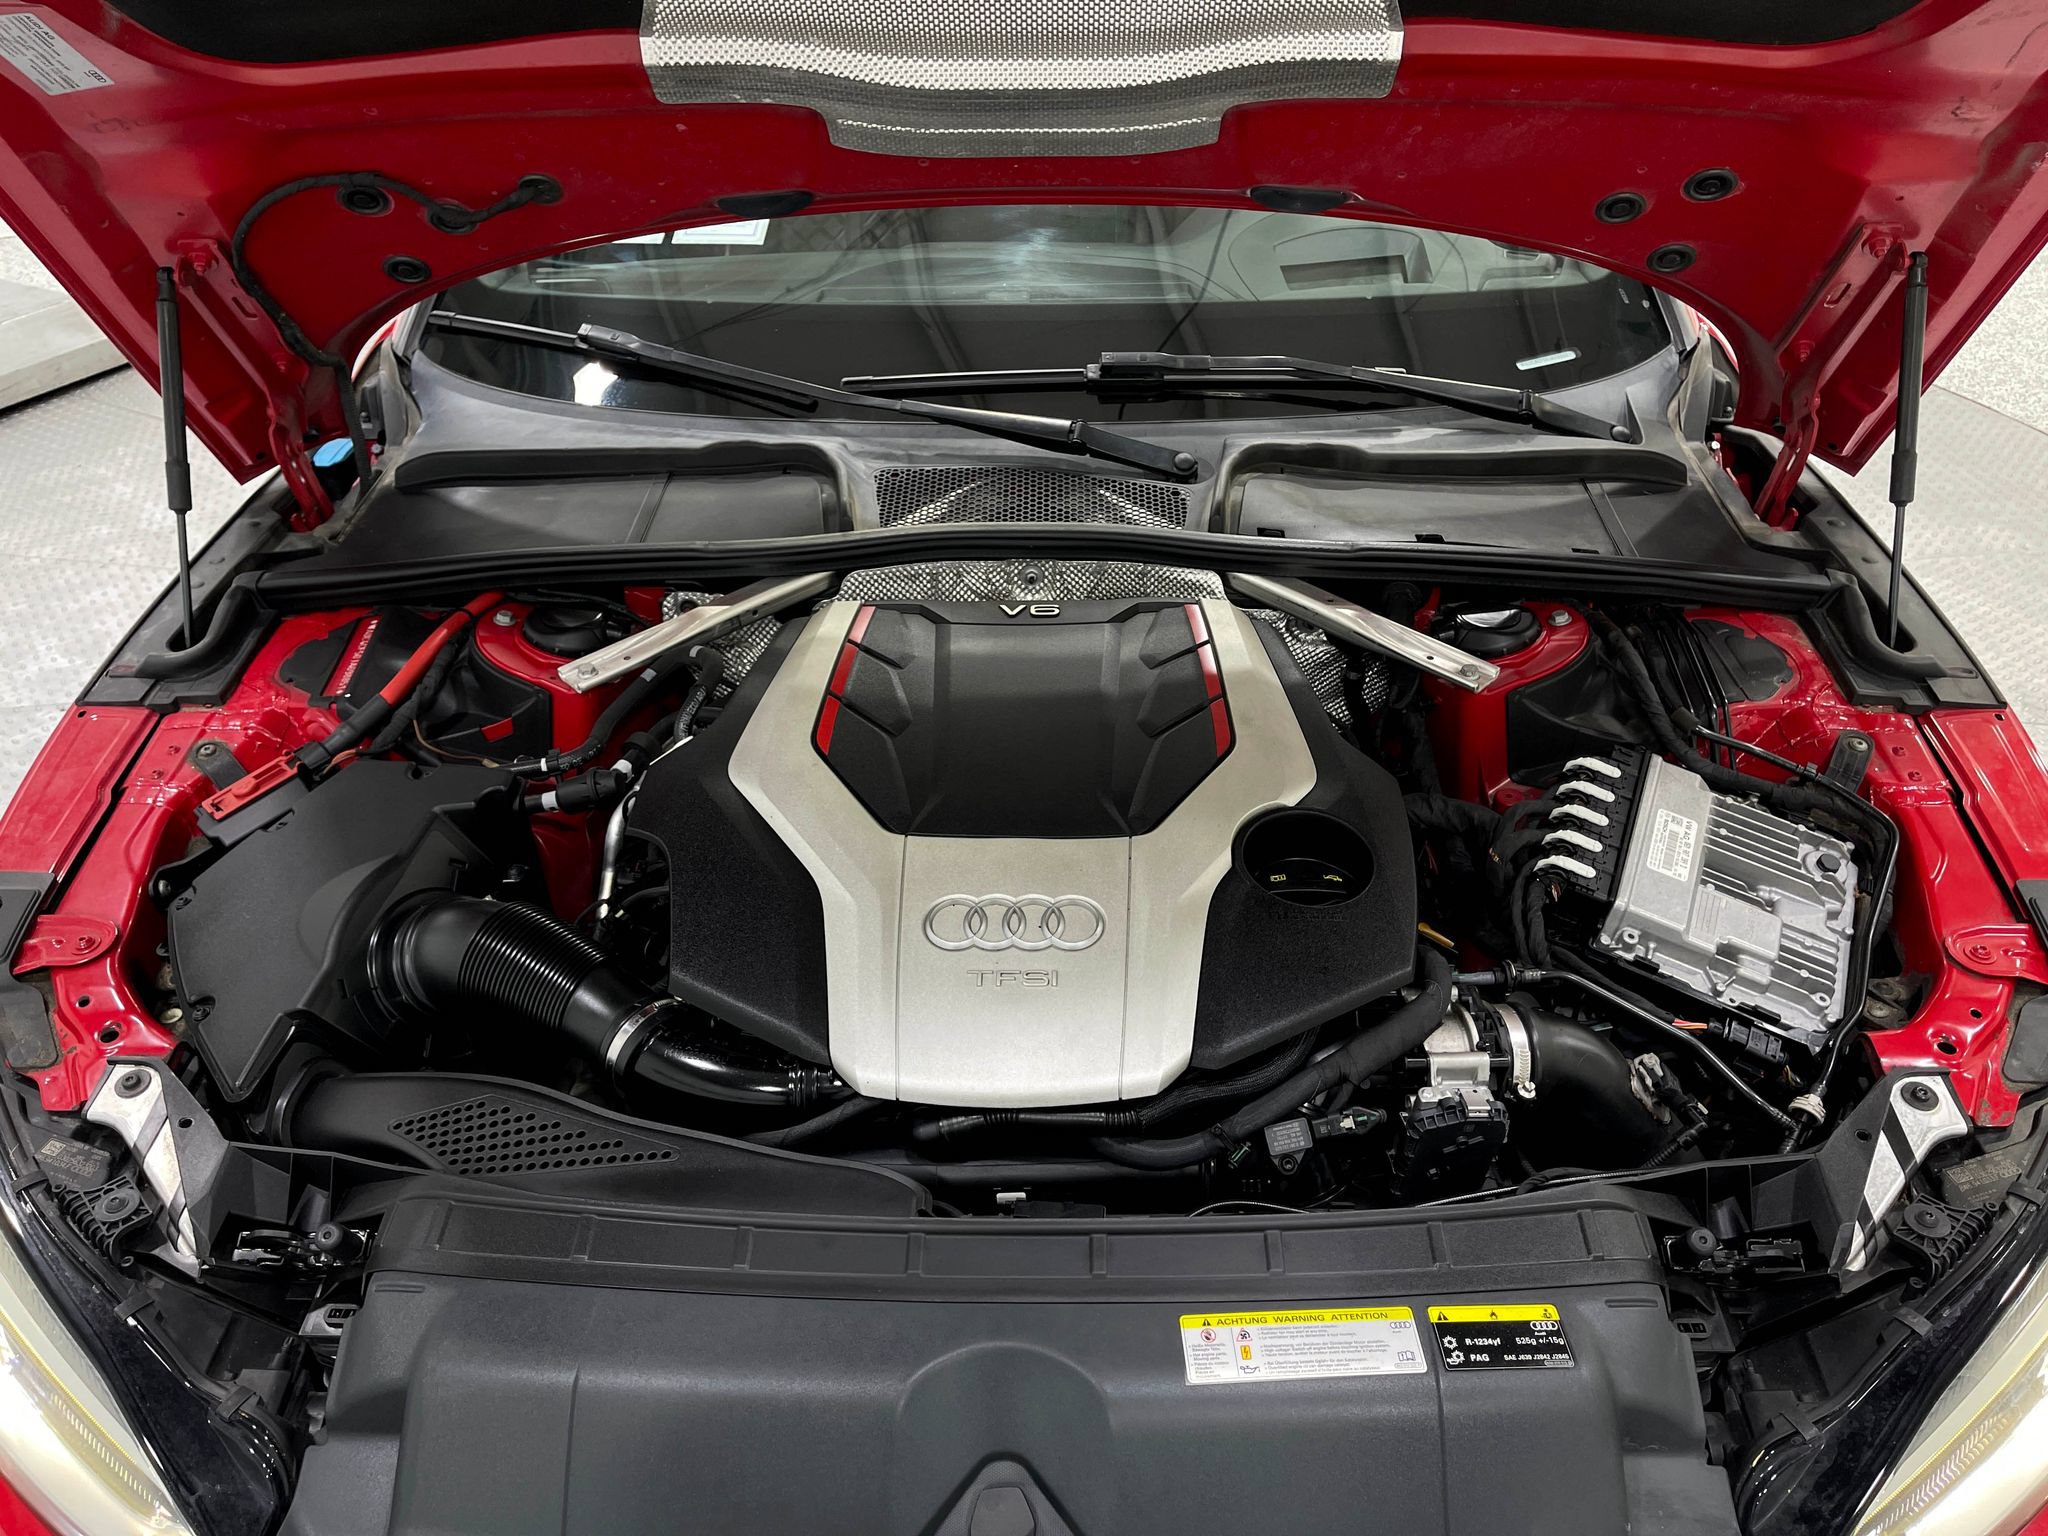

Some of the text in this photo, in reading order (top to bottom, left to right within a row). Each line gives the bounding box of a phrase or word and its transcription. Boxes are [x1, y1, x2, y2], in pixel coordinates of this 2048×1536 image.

[23, 14, 43, 30] AUDI
[42, 29, 56, 41] AG
[999, 604, 1061, 617] V6
[966, 969, 1058, 988] TFSI
[1216, 1312, 1389, 1326] ACHTUNG WARNING ATTENTION
[1464, 1336, 1565, 1347] R-1234yf 525g +/-15g
[1469, 1353, 1490, 1362] PAG
